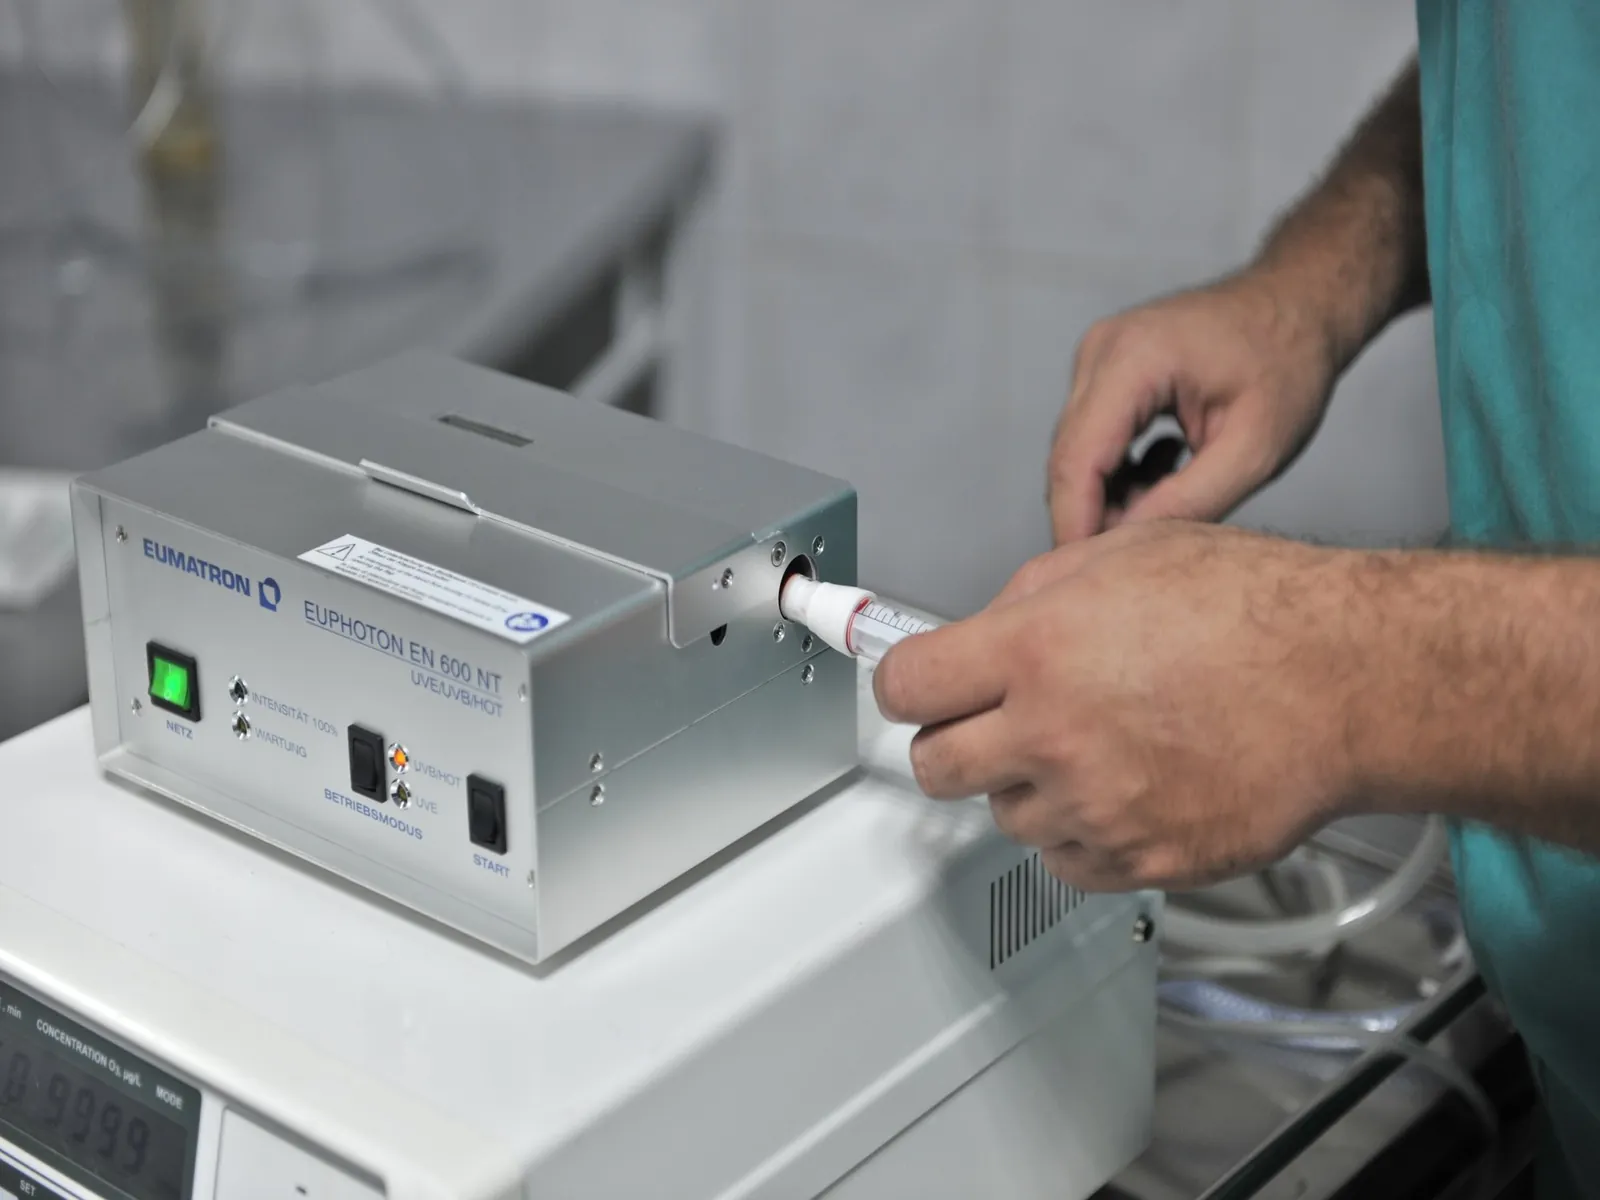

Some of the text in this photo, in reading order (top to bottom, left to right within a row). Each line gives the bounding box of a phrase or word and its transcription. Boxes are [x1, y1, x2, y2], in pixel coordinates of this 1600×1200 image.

[143, 538, 250, 597] EUMATRON
[304, 600, 502, 694] EUPHOTON EN 600 NT
[411, 669, 503, 718] UVE/UVB/HOT
[166, 719, 193, 740] NETZ
[312, 717, 338, 738] 100%
[254, 727, 307, 758] WARTUNG
[413, 759, 461, 788] UVB/HOT
[324, 788, 423, 840] BETRIEBSMODUS
[416, 796, 438, 815] UVE
[473, 853, 510, 878] START
[36, 1018, 107, 1068] CONCENTRATION
[156, 1084, 184, 1111] MODE
[20, 1179, 36, 1197] SET
